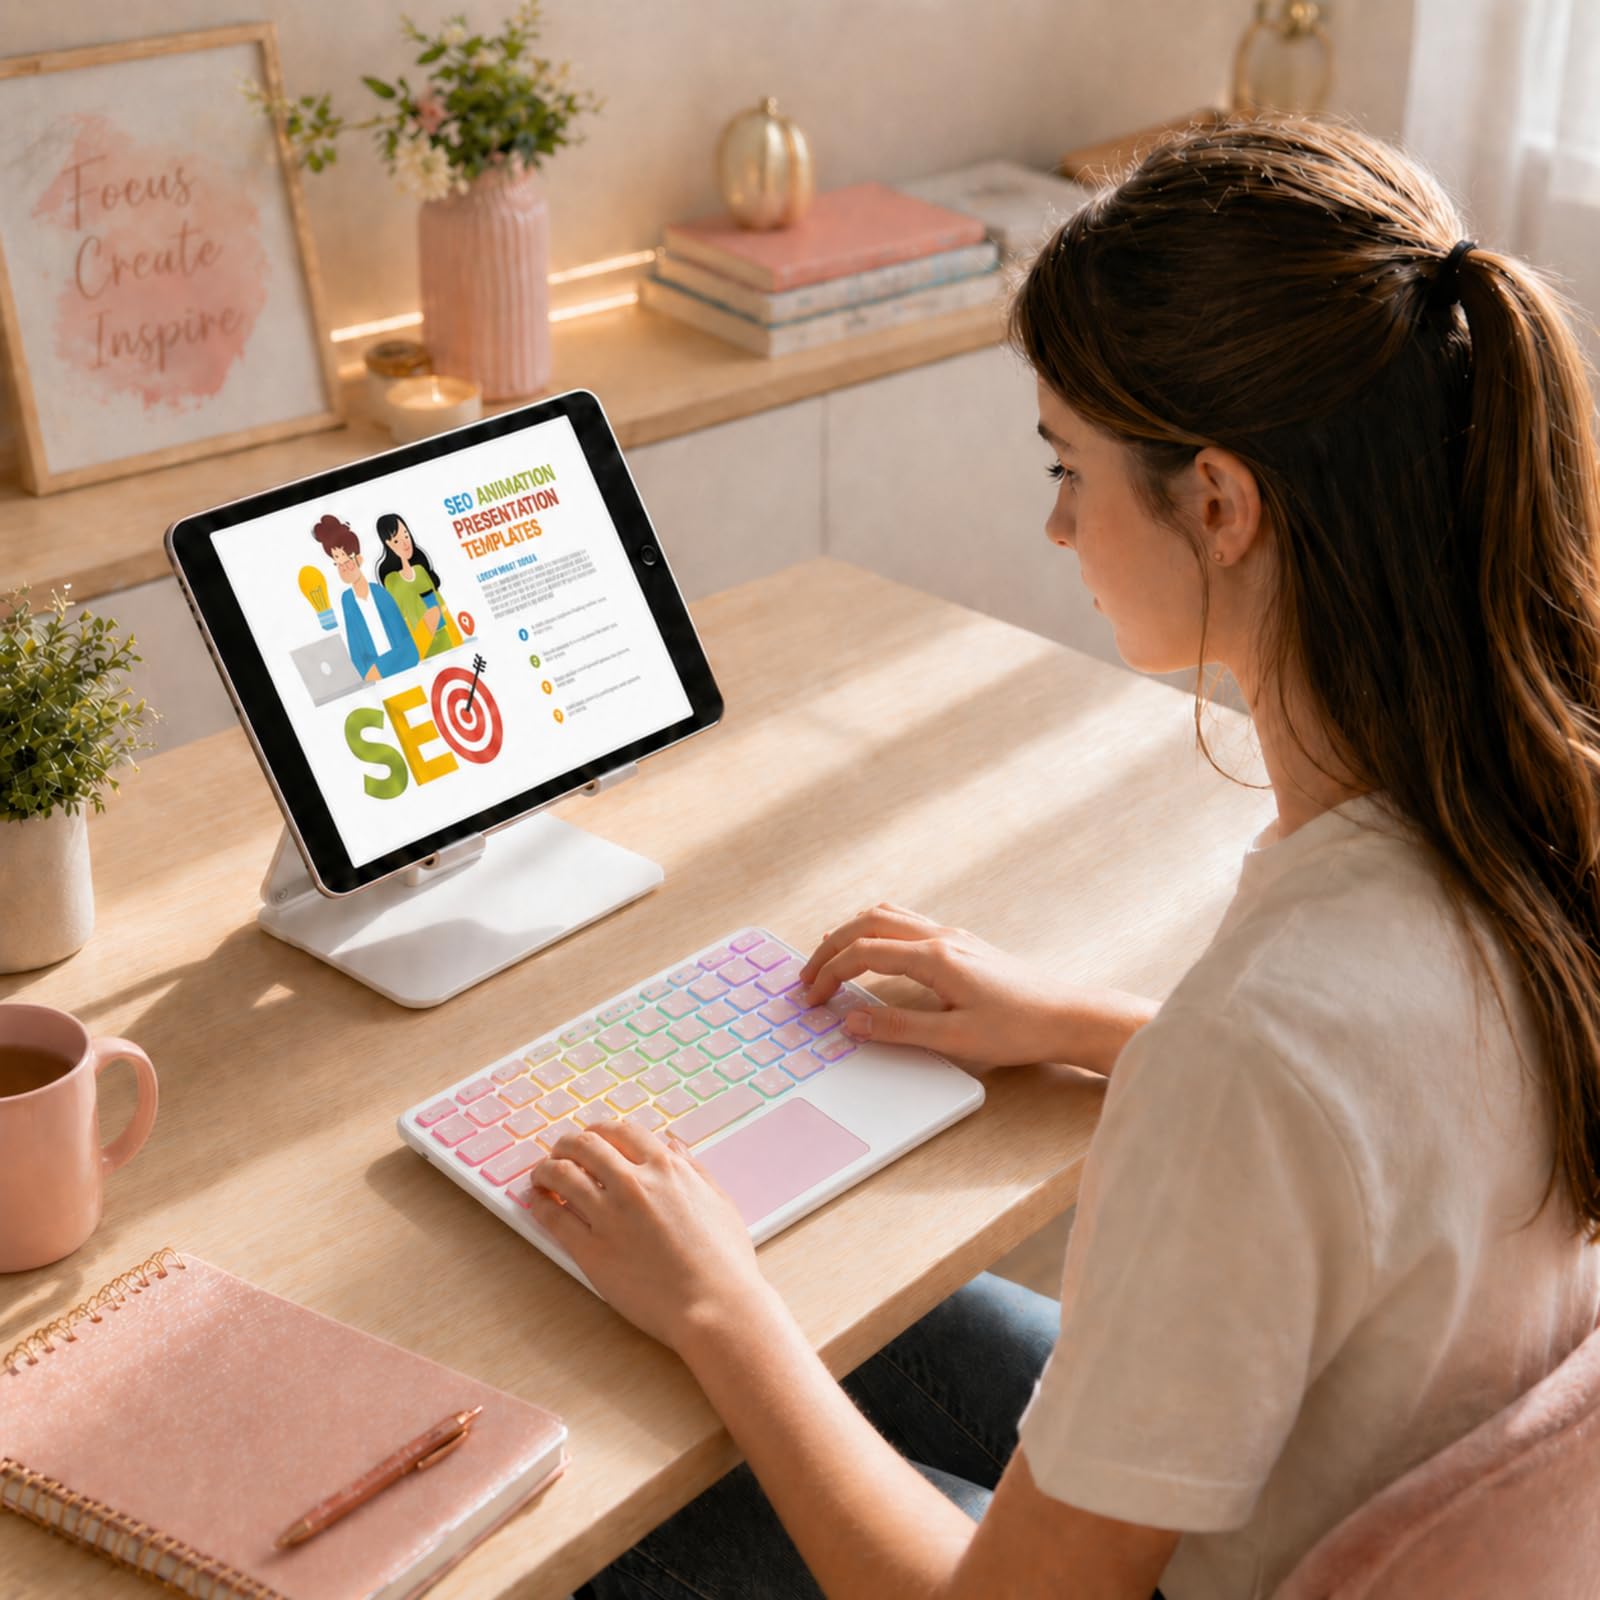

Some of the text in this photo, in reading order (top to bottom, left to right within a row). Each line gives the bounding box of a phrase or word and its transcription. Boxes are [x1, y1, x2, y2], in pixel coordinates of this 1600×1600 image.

[60, 154, 198, 231] Focus
[74, 220, 224, 301] Create
[88, 307, 247, 373] Inspire
[444, 464, 556, 515] SEO ANIMATION
[453, 488, 559, 539] PRESENTATION
[461, 519, 542, 560] TEMPLATES
